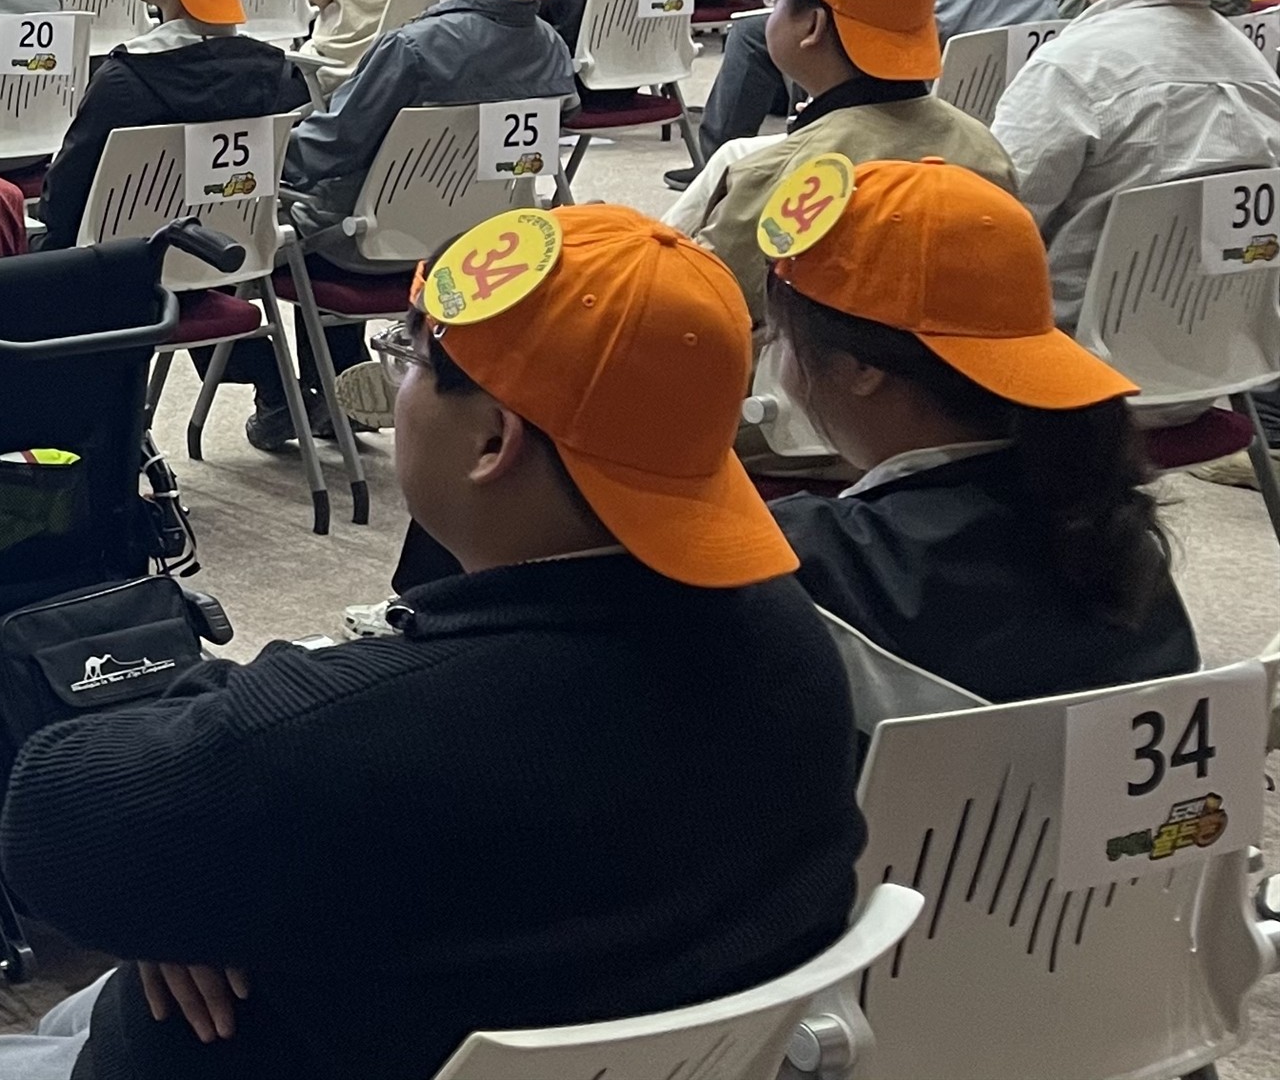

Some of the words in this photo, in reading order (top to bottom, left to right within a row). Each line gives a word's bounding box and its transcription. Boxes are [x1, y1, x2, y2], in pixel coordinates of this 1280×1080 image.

[19, 21, 54, 49] 20
[212, 130, 250, 169] 25
[504, 112, 539, 148] 25
[780, 175, 835, 234] 34
[1232, 182, 1276, 229] 30
[461, 231, 530, 301] 34
[1127, 696, 1217, 797] 34
